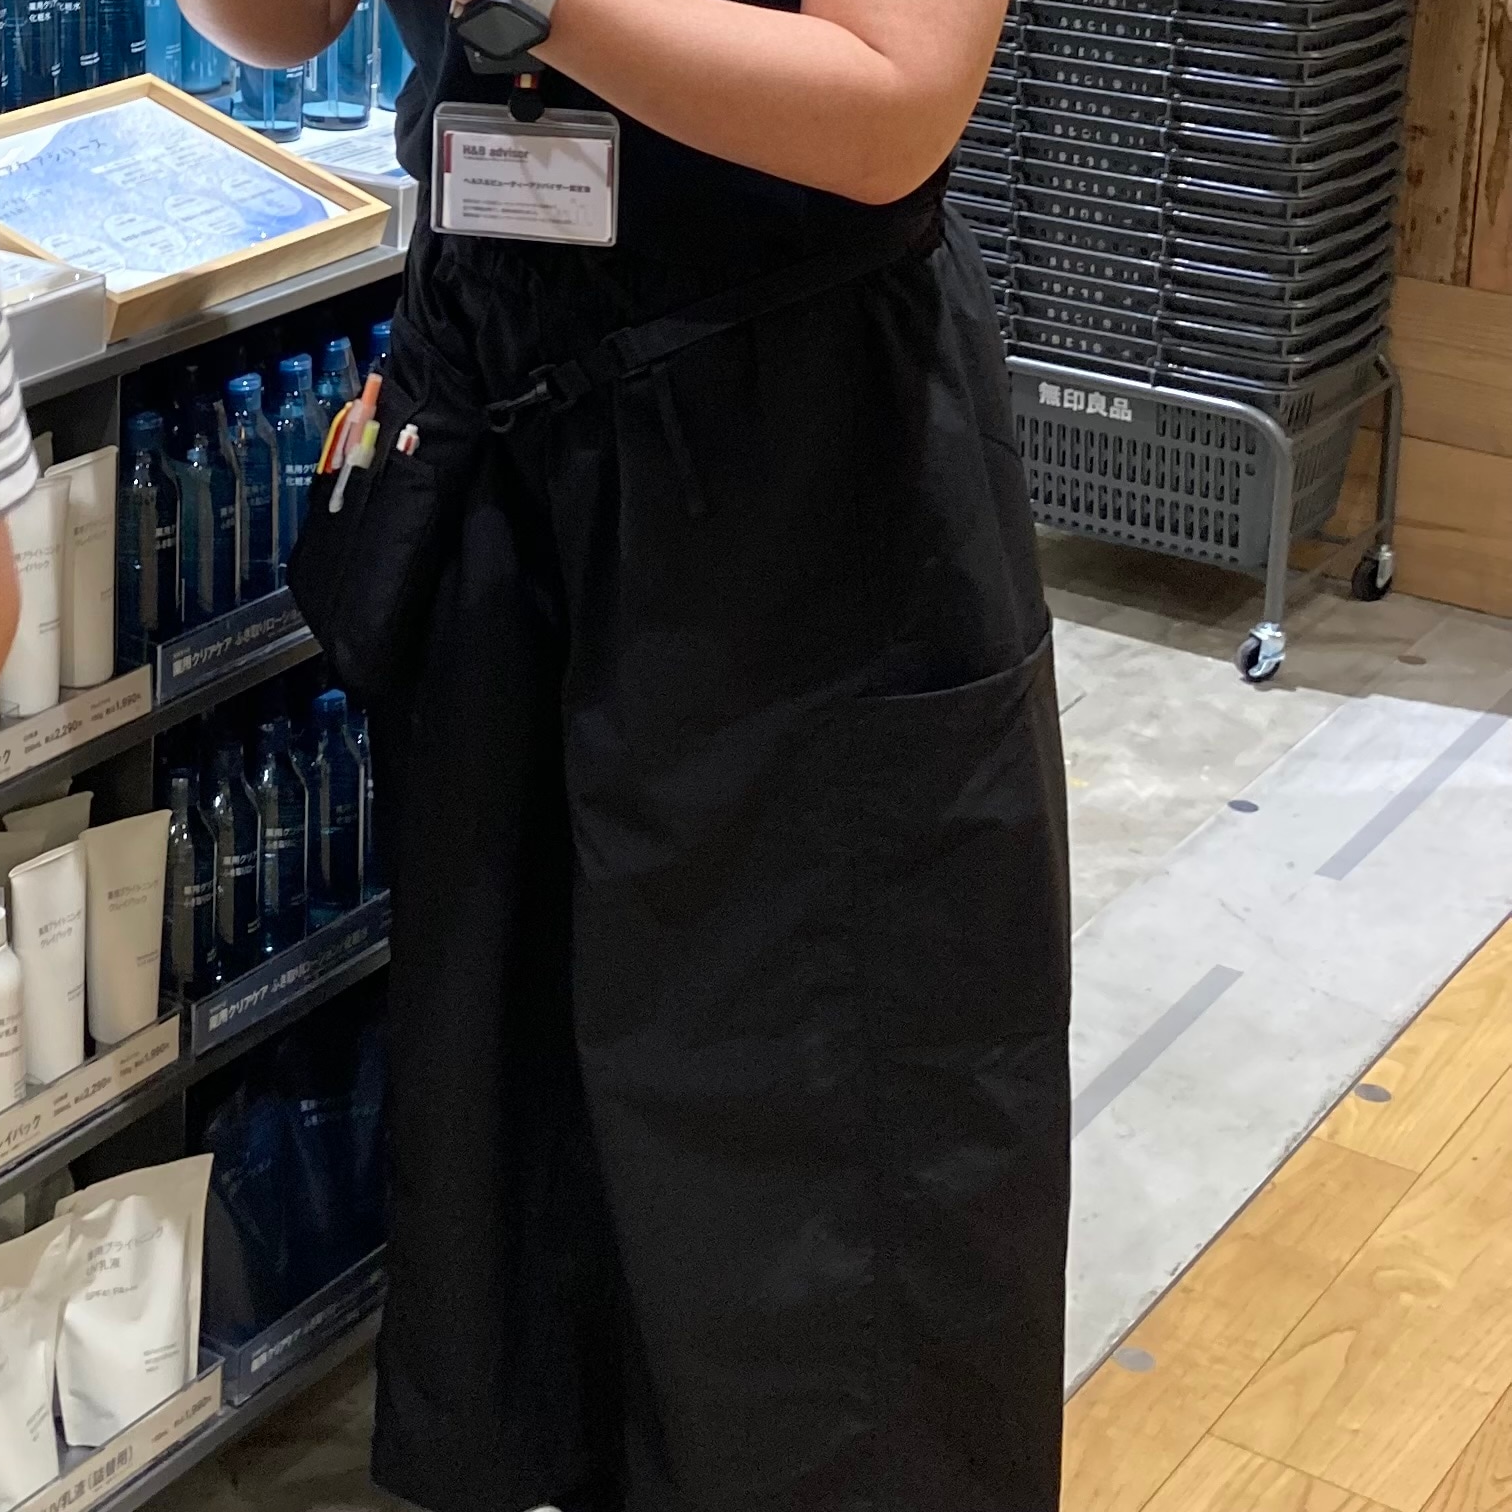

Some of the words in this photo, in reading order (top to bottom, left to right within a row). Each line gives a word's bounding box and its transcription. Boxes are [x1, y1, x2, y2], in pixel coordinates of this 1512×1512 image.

[463, 144, 486, 156] H&B
[489, 146, 529, 159] advisor
[1038, 381, 1132, 423] 無印良品
